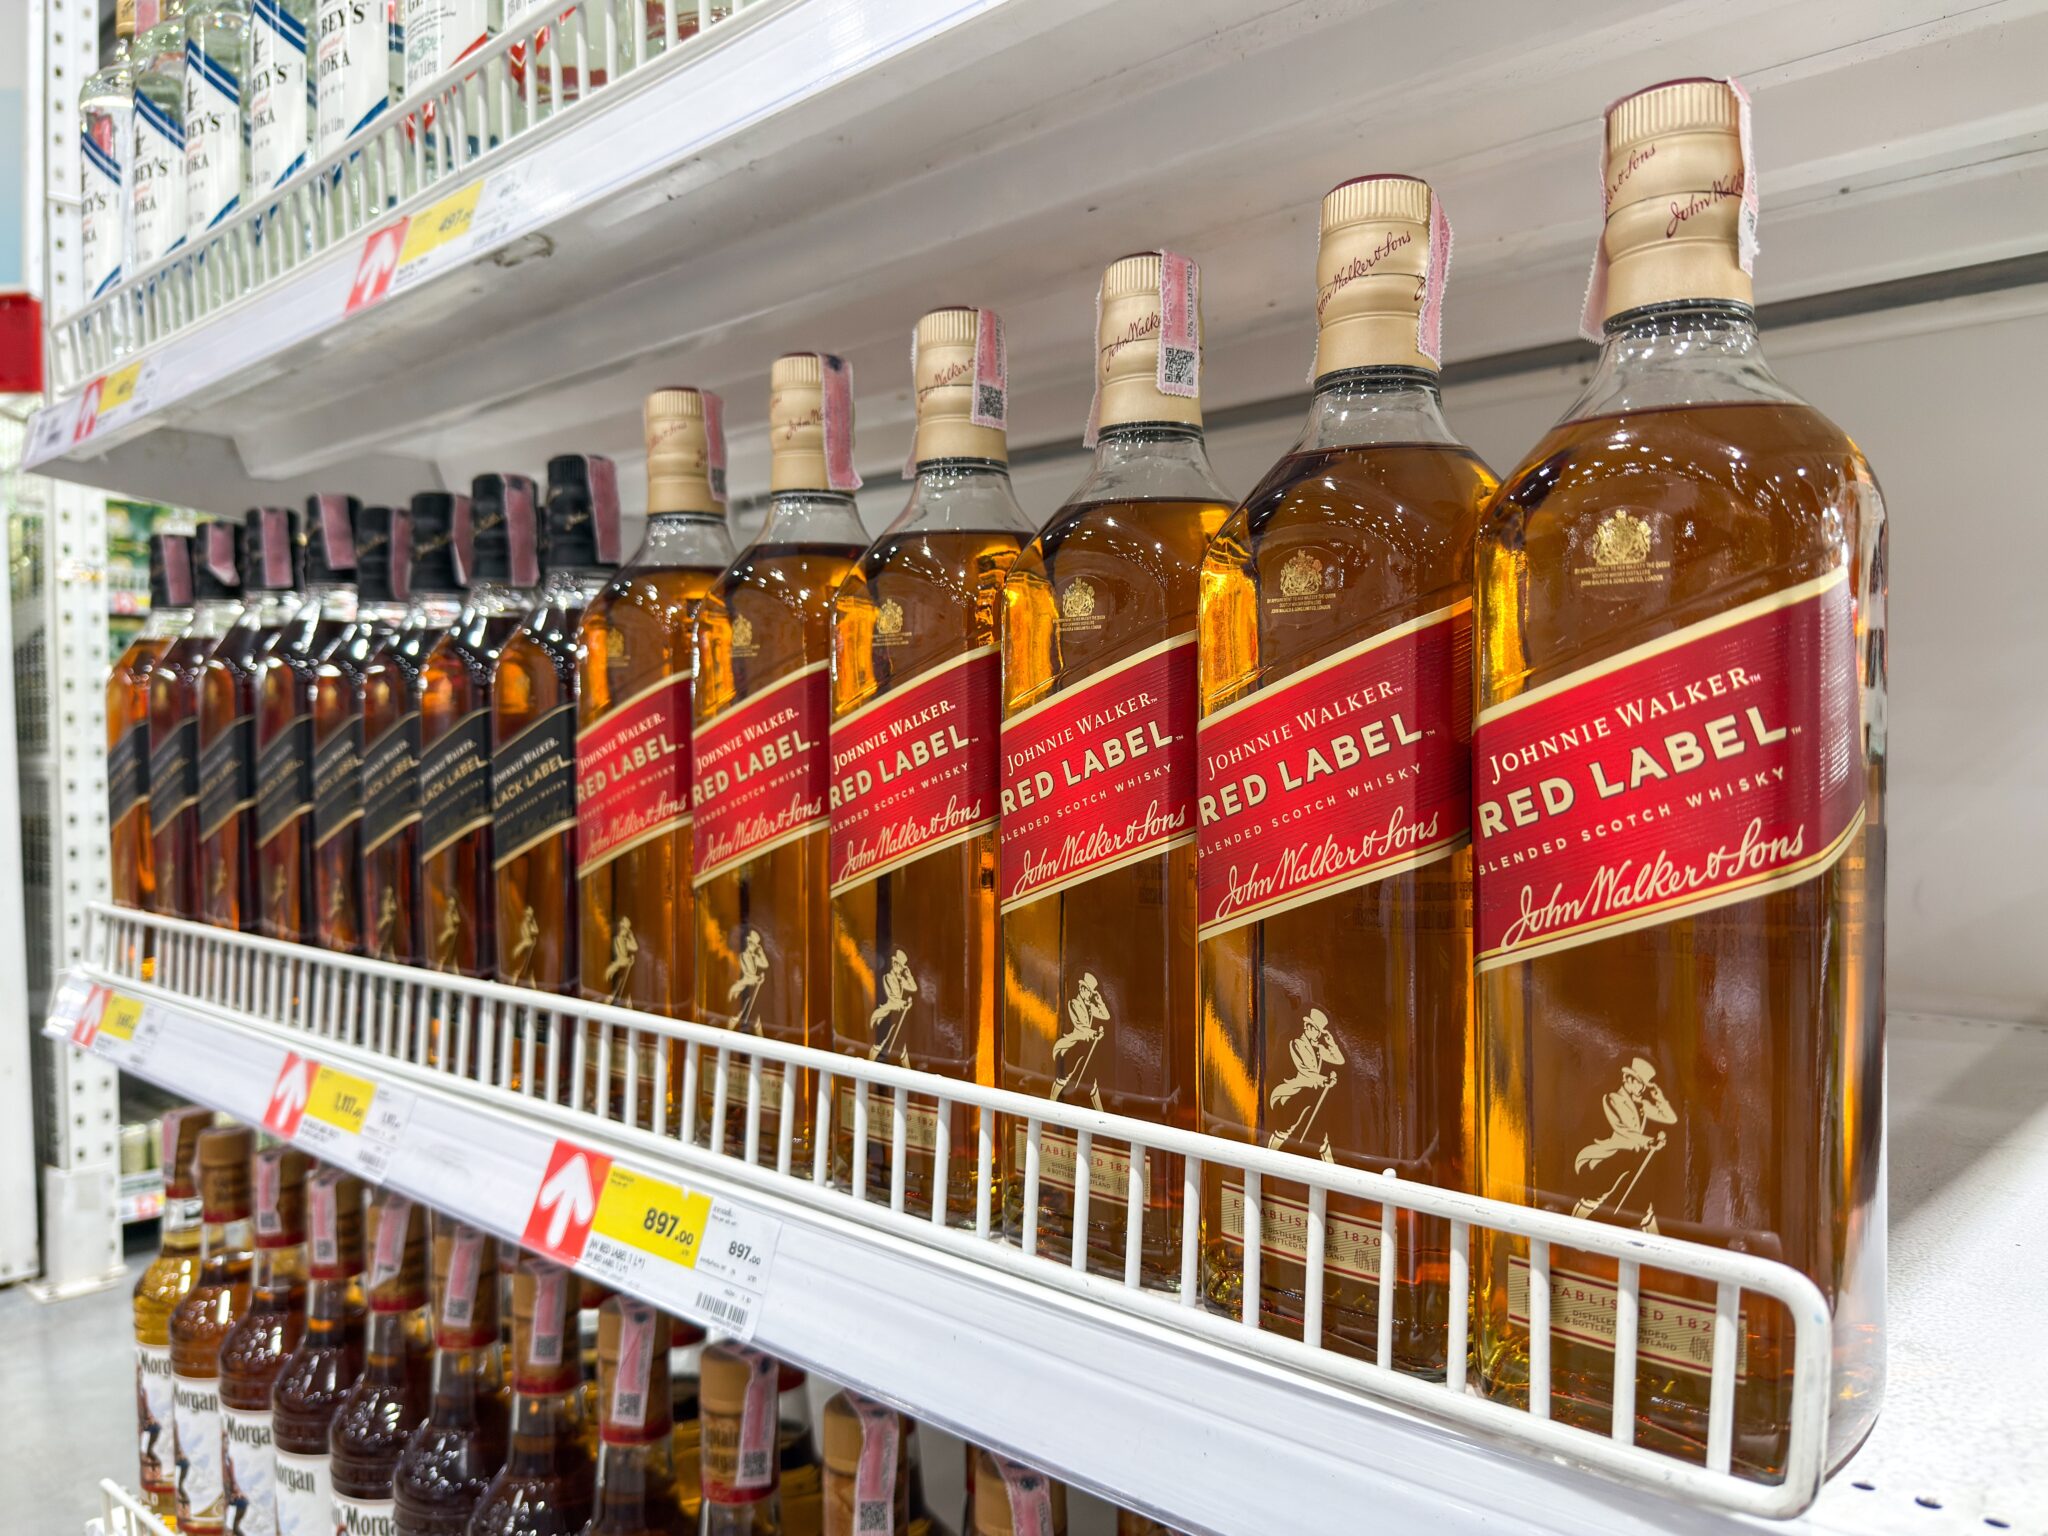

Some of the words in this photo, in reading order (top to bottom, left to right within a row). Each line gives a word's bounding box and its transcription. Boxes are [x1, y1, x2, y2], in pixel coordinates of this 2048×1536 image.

[579, 736, 618, 777] JOHNNIE
[617, 711, 664, 745] WALKER
[696, 734, 744, 777] JOHNNIE
[743, 707, 796, 743] WALKER
[832, 730, 889, 776] JOHNNIE
[889, 699, 951, 739] WALKER
[1007, 726, 1075, 777] JOHNNIE
[1075, 691, 1152, 736] WALKER
[1207, 723, 1293, 782] JOHNNIE
[1295, 680, 1395, 732] WALKER
[1489, 716, 1611, 785] JOHNNIE
[1614, 666, 1750, 729] WALKER
[525, 753, 573, 789] LABEL
[577, 769, 607, 805] RED
[609, 733, 677, 783] LABEL
[691, 768, 730, 808] RED
[733, 729, 812, 784] LABEL
[829, 769, 872, 811] RED
[878, 723, 970, 785] LABEL
[874, 786, 916, 812] SCOTCH
[920, 762, 969, 790] WHISKY
[1000, 770, 1055, 818] RED
[1061, 720, 1174, 788] LABEL
[1056, 790, 1108, 819] SCOTCH
[1114, 762, 1173, 794] WHISKY
[1198, 773, 1268, 828] RED
[1276, 712, 1423, 793] LABEL
[1271, 795, 1337, 829] SCOTCH
[1347, 762, 1423, 799] WHISKY
[1477, 775, 1575, 839] RED
[1587, 705, 1789, 799] LABEL
[1580, 803, 1672, 842] SCOTCH
[1685, 765, 1787, 809] WHISKY
[837, 839, 878, 884] John
[878, 815, 932, 860] Walker
[940, 794, 982, 833] Sons
[1012, 846, 1059, 899] John
[1061, 822, 1127, 873] Walker
[1138, 799, 1186, 843] Sons
[1214, 862, 1275, 921] John
[1278, 832, 1358, 890] Walker
[1378, 805, 1439, 856] Sons
[1500, 882, 1586, 950] John
[1589, 849, 1700, 915] Walker
[1727, 816, 1805, 878] Sons
[1109, 1161, 1130, 1174] 182
[643, 1207, 694, 1247] 897.00
[728, 1240, 762, 1266] 897.00
[1343, 1230, 1381, 1248] 1820
[1675, 1314, 1712, 1333] 182
[141, 1351, 171, 1376] Morg
[226, 1413, 271, 1448] Morga
